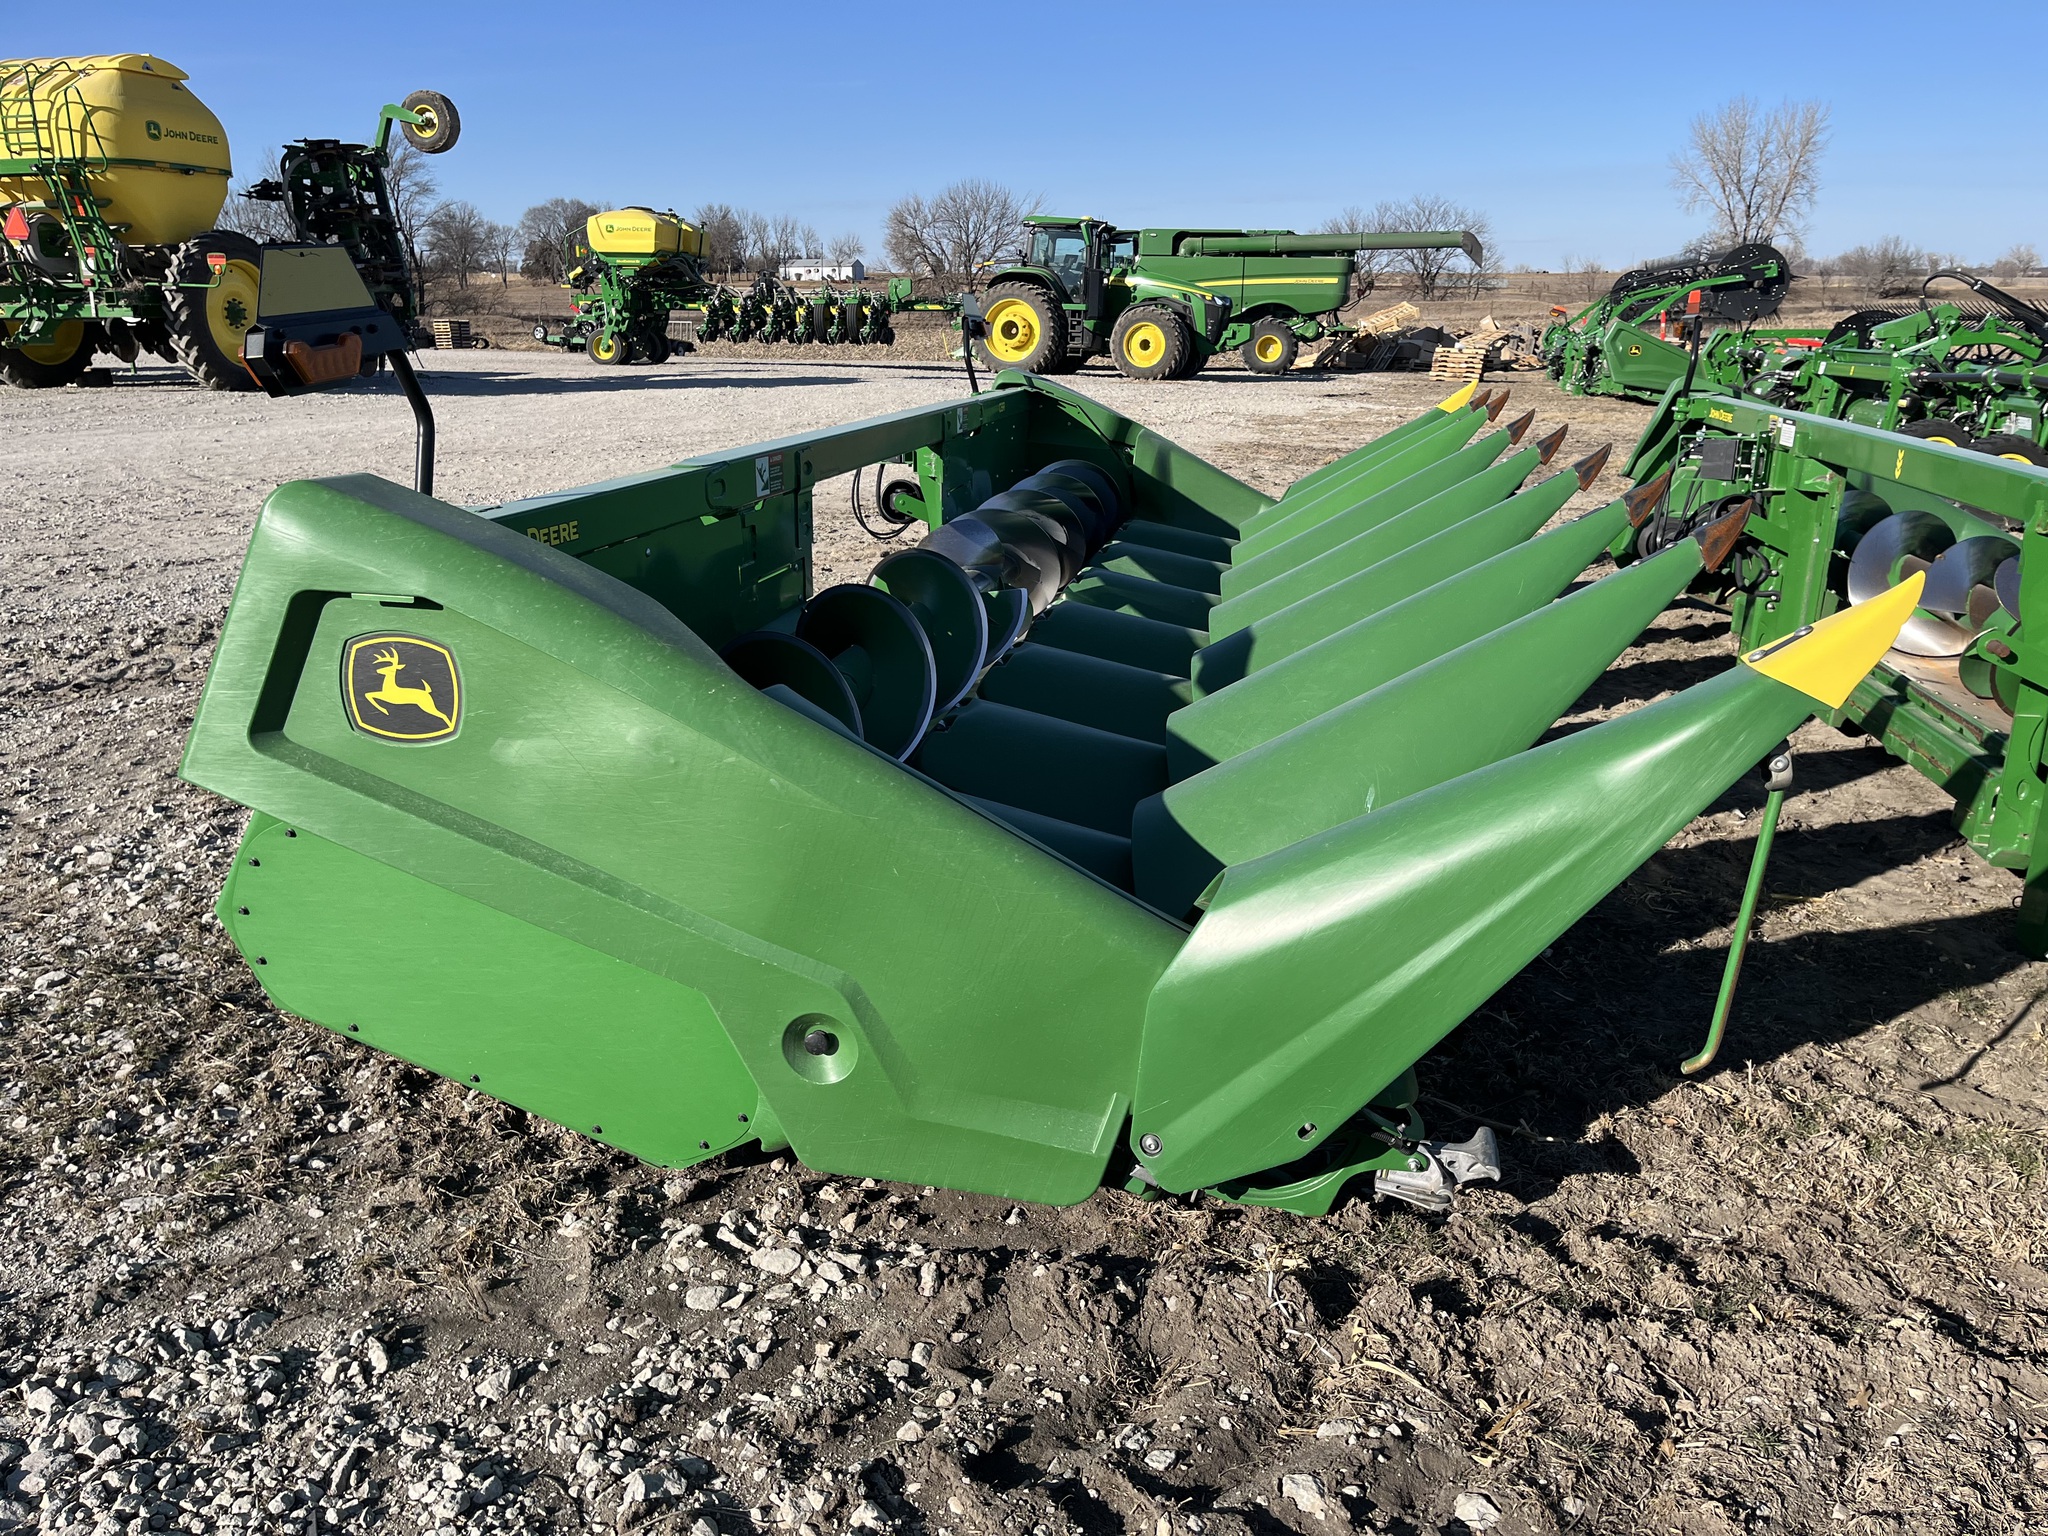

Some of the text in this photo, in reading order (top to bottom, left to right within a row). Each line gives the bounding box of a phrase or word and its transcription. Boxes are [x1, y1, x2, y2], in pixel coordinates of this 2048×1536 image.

[164, 128, 219, 144] JOHN DEERE
[1708, 407, 1733, 423] JOHN DEERE
[526, 520, 579, 546] DEERE
